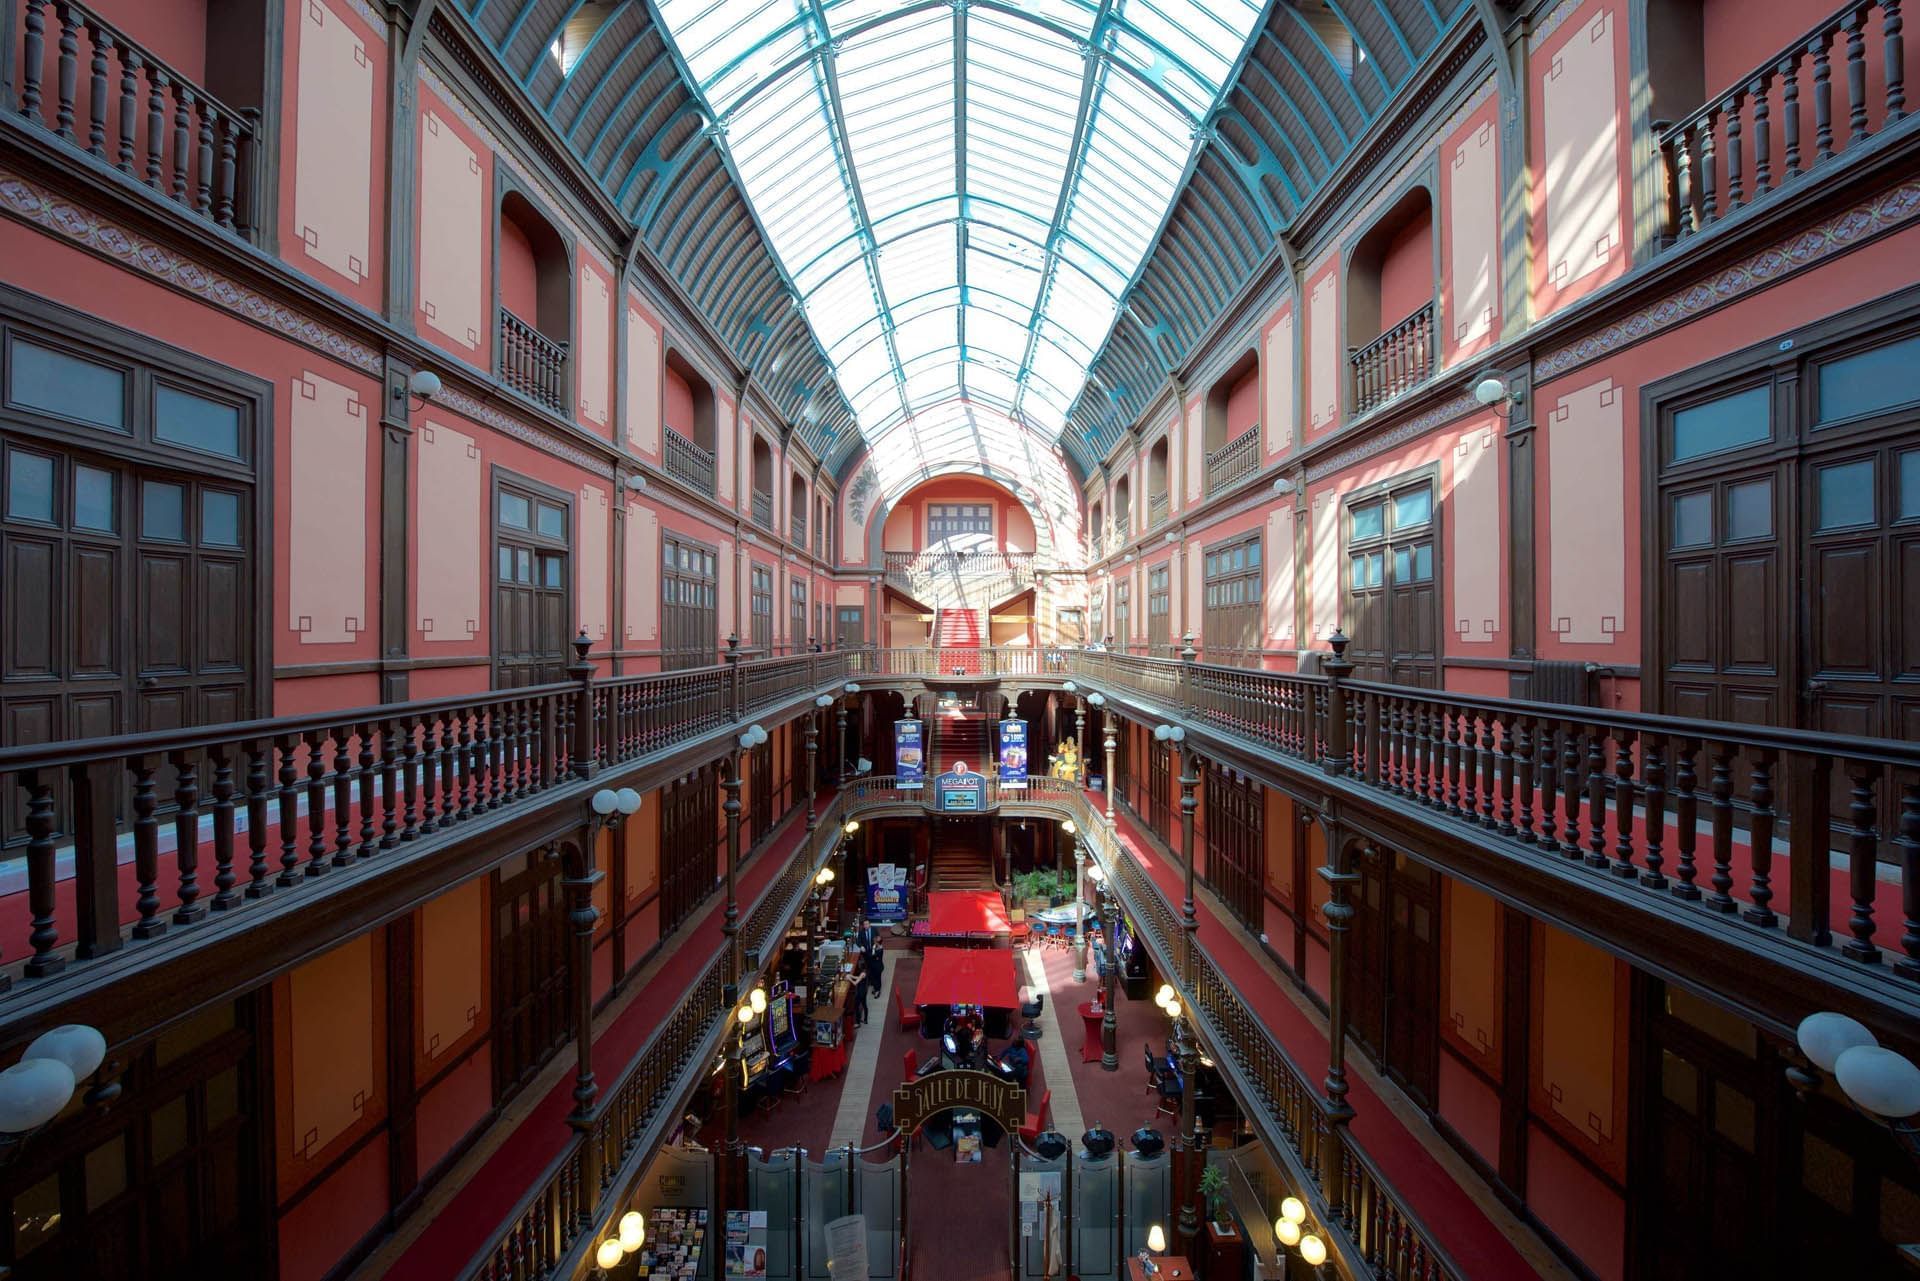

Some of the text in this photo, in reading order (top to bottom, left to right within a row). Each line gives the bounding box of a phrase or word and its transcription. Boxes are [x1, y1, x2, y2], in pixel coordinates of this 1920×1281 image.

[915, 1078, 1004, 1118] SALLE DE JEUX
